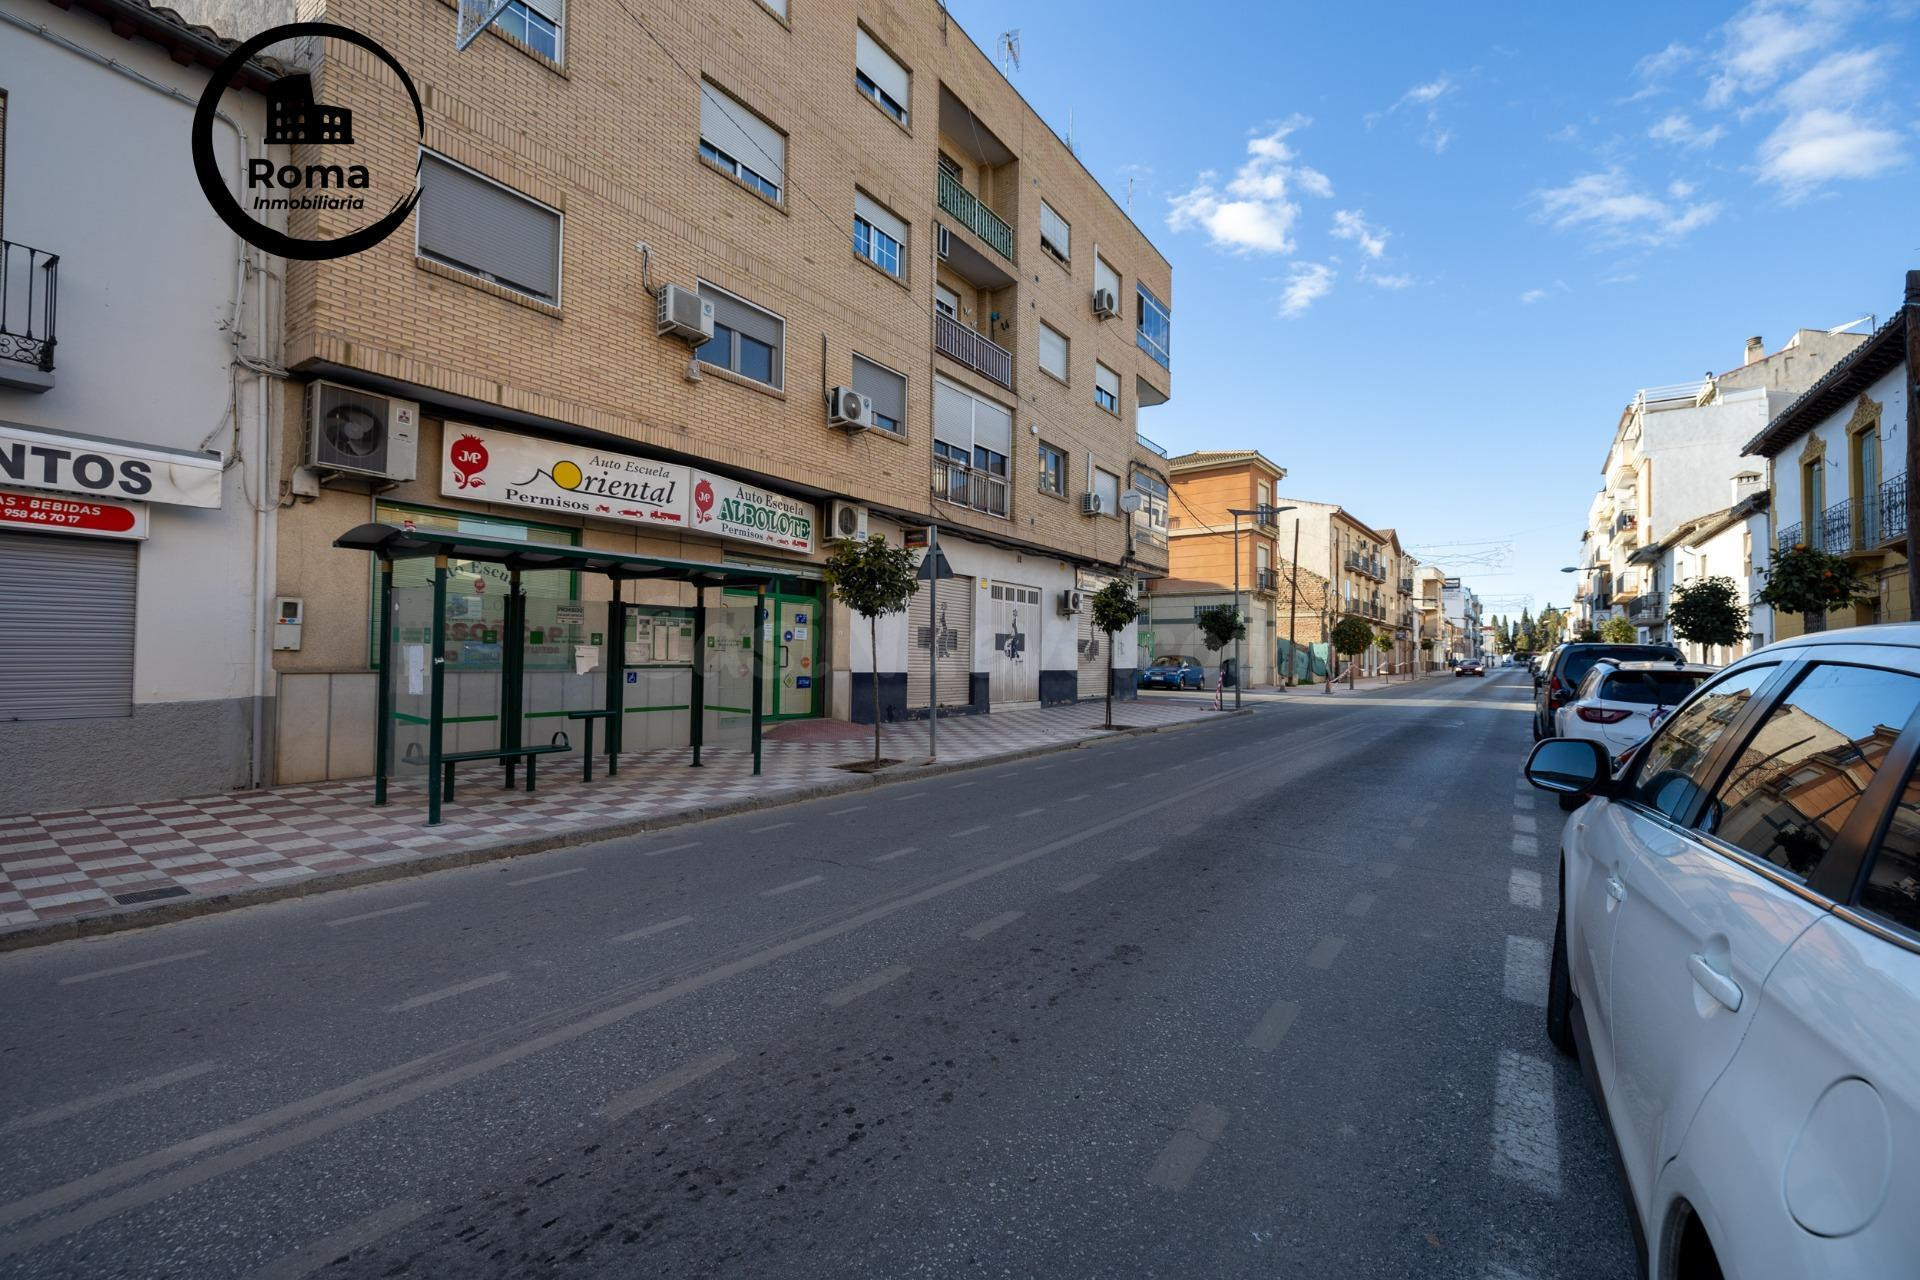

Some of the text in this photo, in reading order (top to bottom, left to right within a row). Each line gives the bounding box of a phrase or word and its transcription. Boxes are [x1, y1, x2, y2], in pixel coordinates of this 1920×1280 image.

[0, 443, 153, 495] NTOS
[589, 454, 671, 480] Auto Escuela
[30, 499, 102, 516] BEBIDAS
[505, 487, 591, 512] Permisos
[735, 486, 805, 517] Auto Escuela
[4, 508, 81, 524] 958 46 70 17
[717, 497, 812, 541] ALBOLOTE
[721, 522, 765, 542] Permisos
